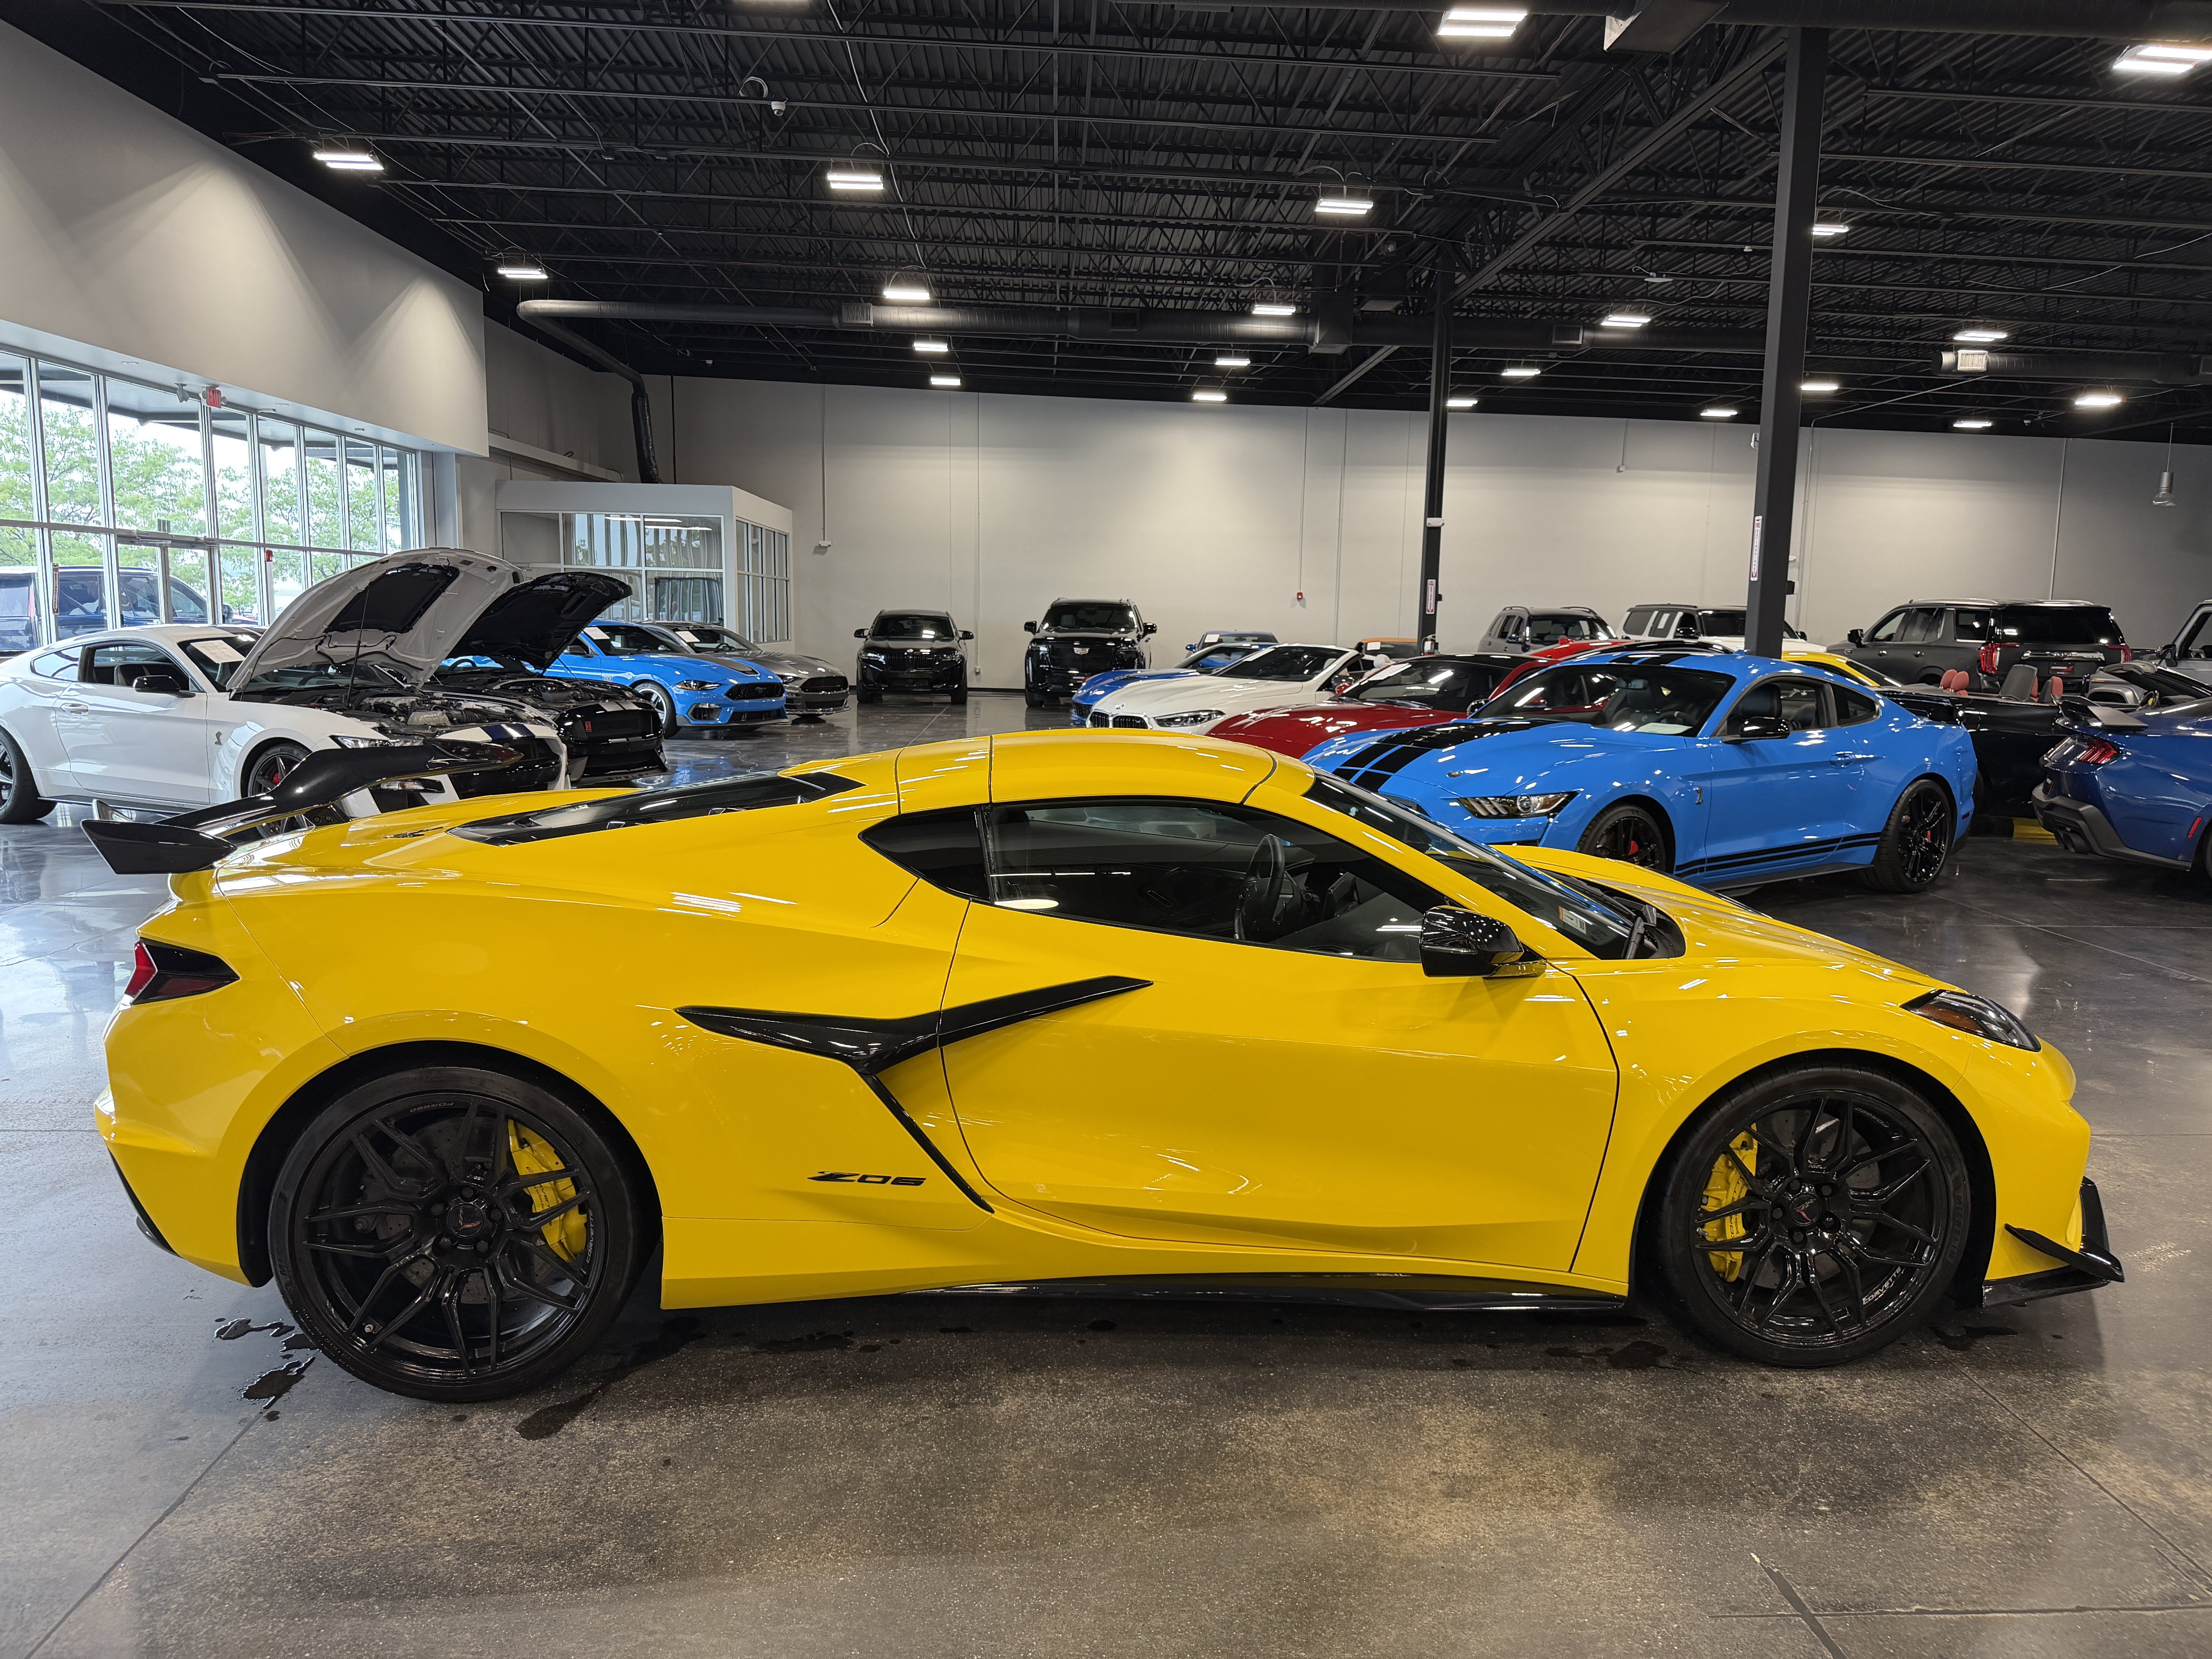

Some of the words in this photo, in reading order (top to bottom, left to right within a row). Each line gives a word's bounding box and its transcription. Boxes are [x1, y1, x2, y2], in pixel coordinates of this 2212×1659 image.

[208, 388, 220, 407] EXIT
[410, 1102, 454, 1113] FORGED
[807, 1171, 927, 1186] Z06
[1862, 1266, 1901, 1305] CORVETTE
